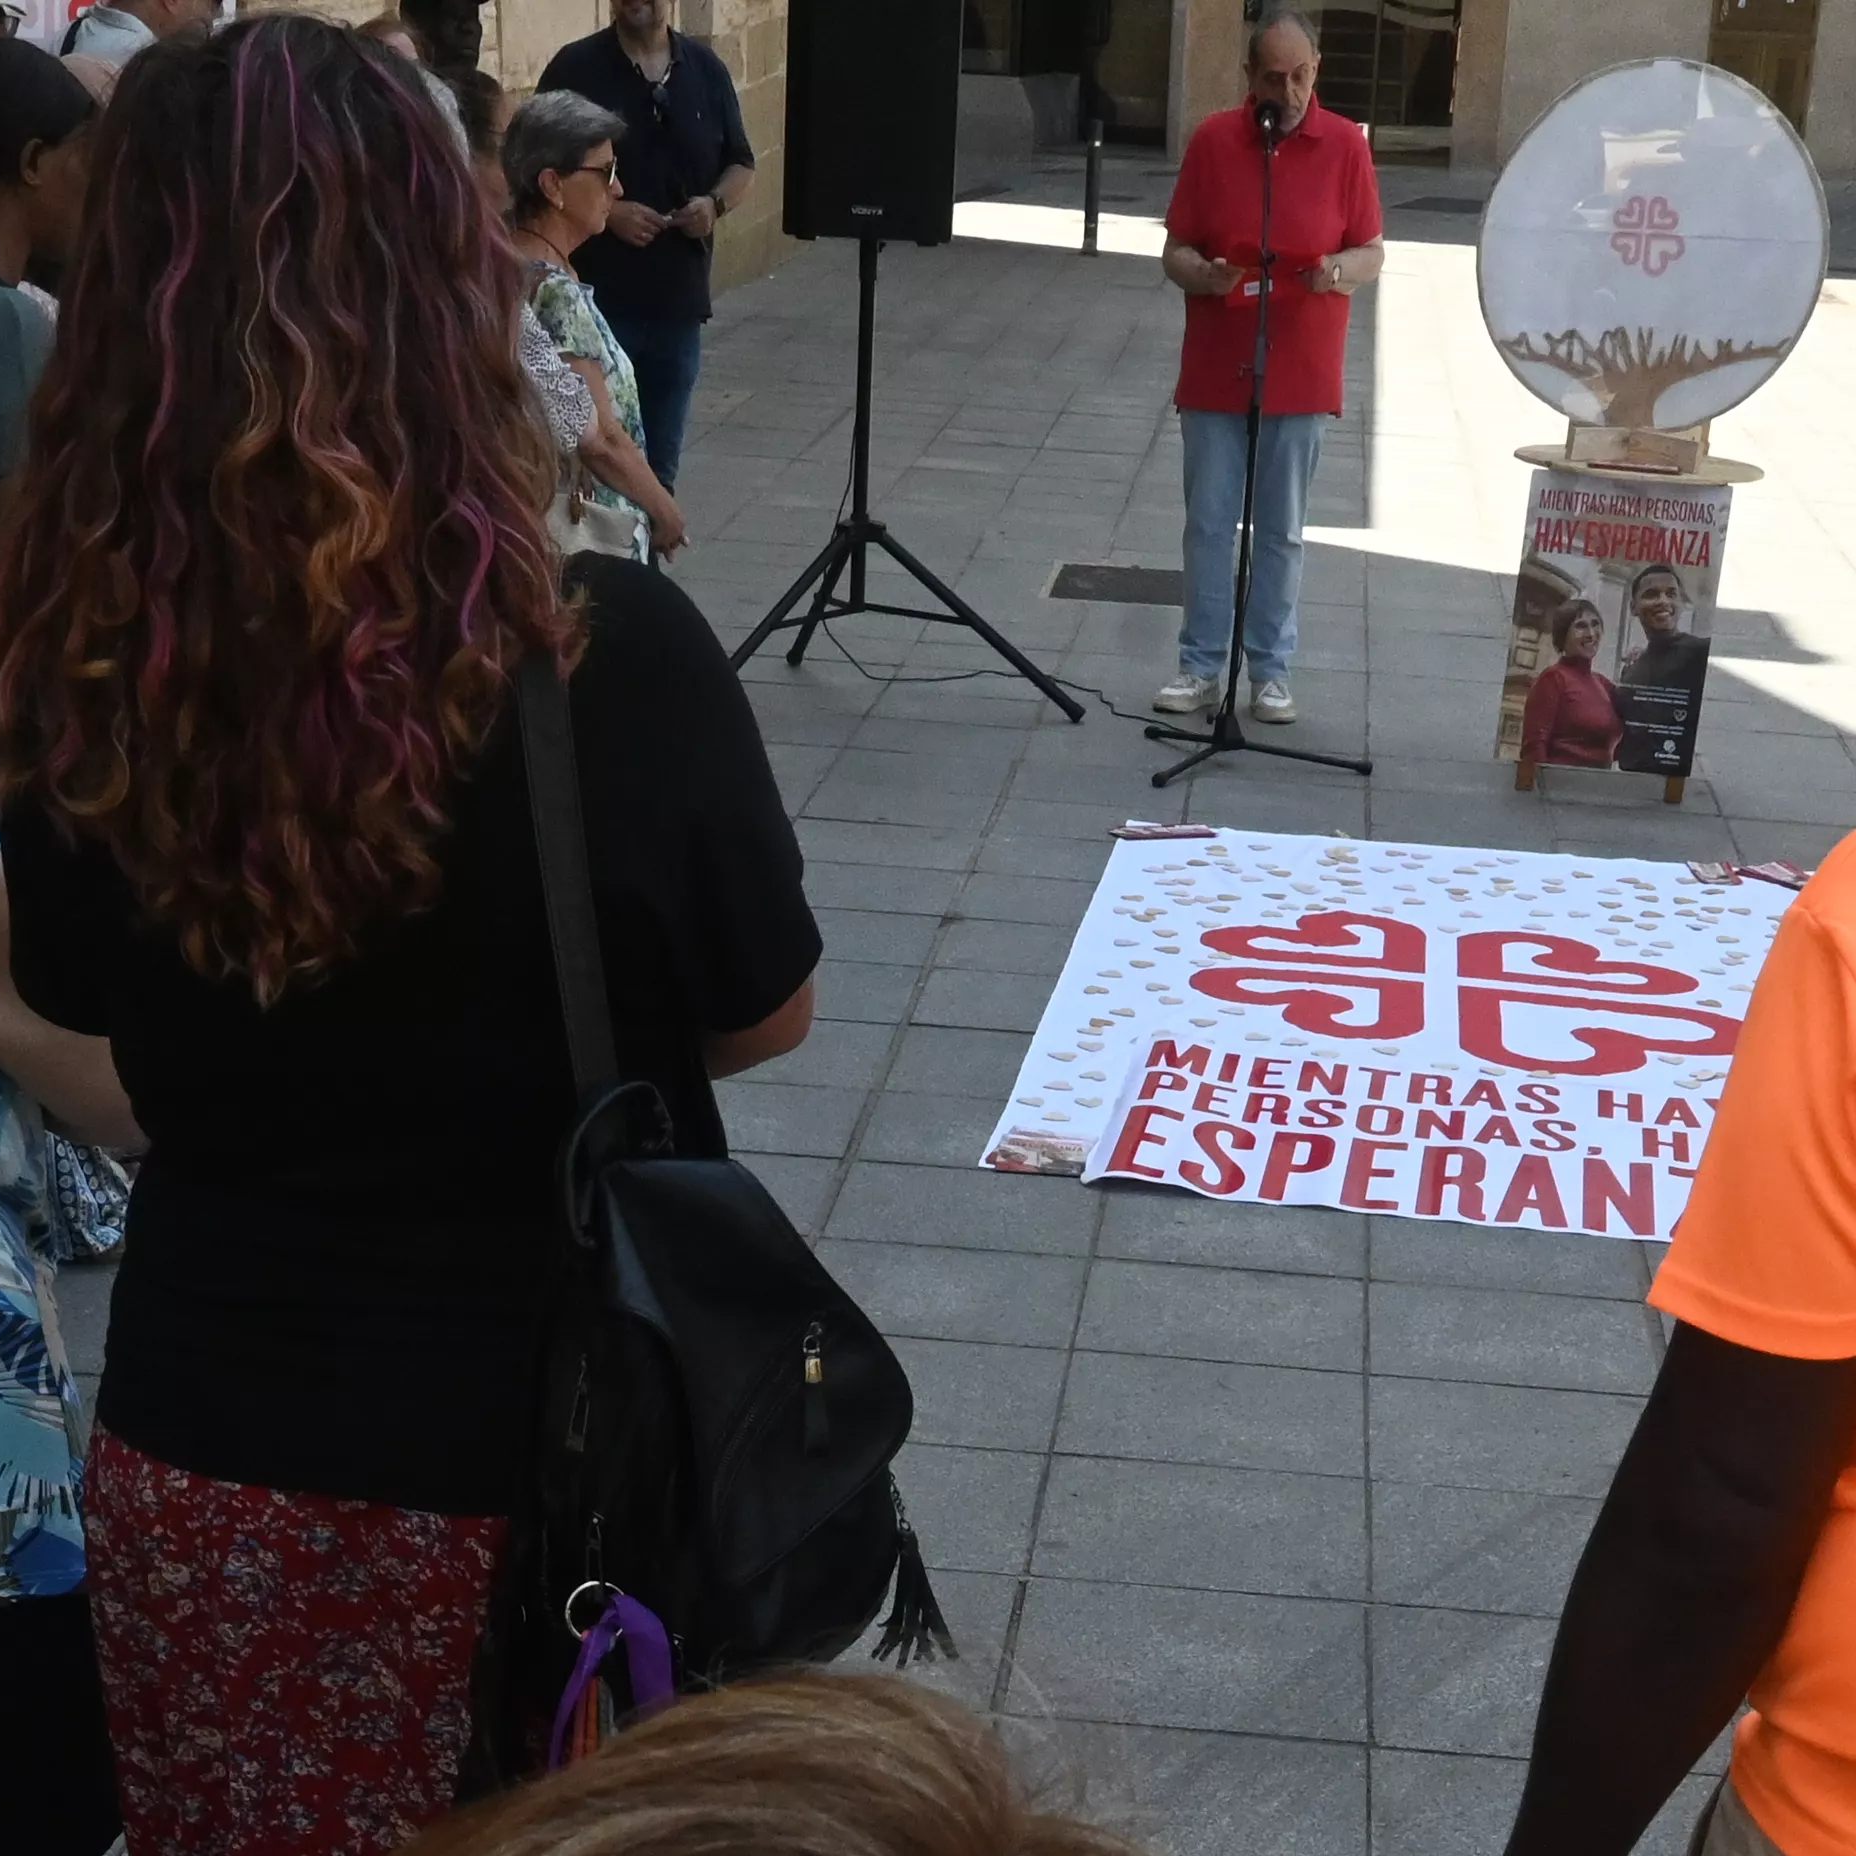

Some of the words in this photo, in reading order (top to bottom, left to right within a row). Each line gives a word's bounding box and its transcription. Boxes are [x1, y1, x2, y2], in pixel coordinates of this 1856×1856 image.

[1539, 489, 1606, 516] MIENTRAS
[1609, 495, 1642, 519] HAYA
[1645, 499, 1716, 527] PERSONAS,
[1534, 517, 1581, 555] HAY
[1582, 521, 1711, 568] ESPERANZA
[1138, 1071, 1603, 1156] PERSONAS,
[1145, 1040, 1560, 1114] MIENTRAS
[1597, 1089, 1721, 1128] HA
